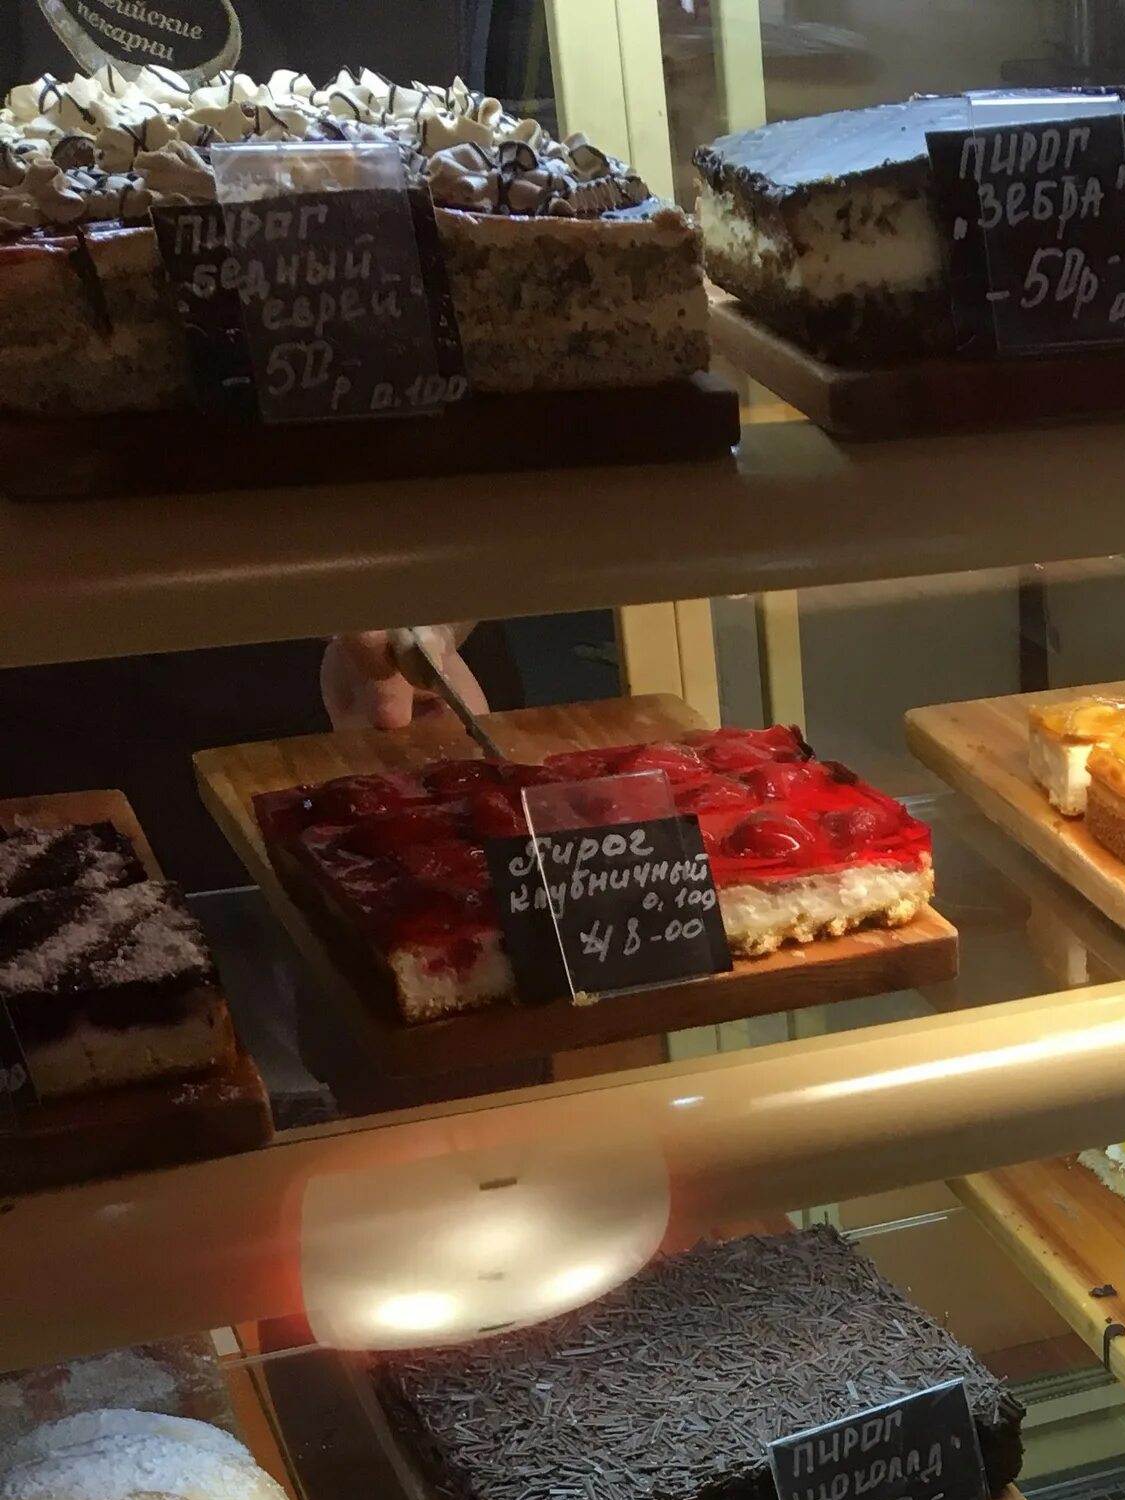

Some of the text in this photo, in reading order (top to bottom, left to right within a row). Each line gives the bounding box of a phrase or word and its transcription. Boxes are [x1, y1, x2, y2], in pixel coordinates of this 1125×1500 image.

[959, 127, 1091, 180] ПИРОГ
[174, 203, 328, 256] ПИРОГ
[792, 1408, 904, 1478] ПИРОГ
